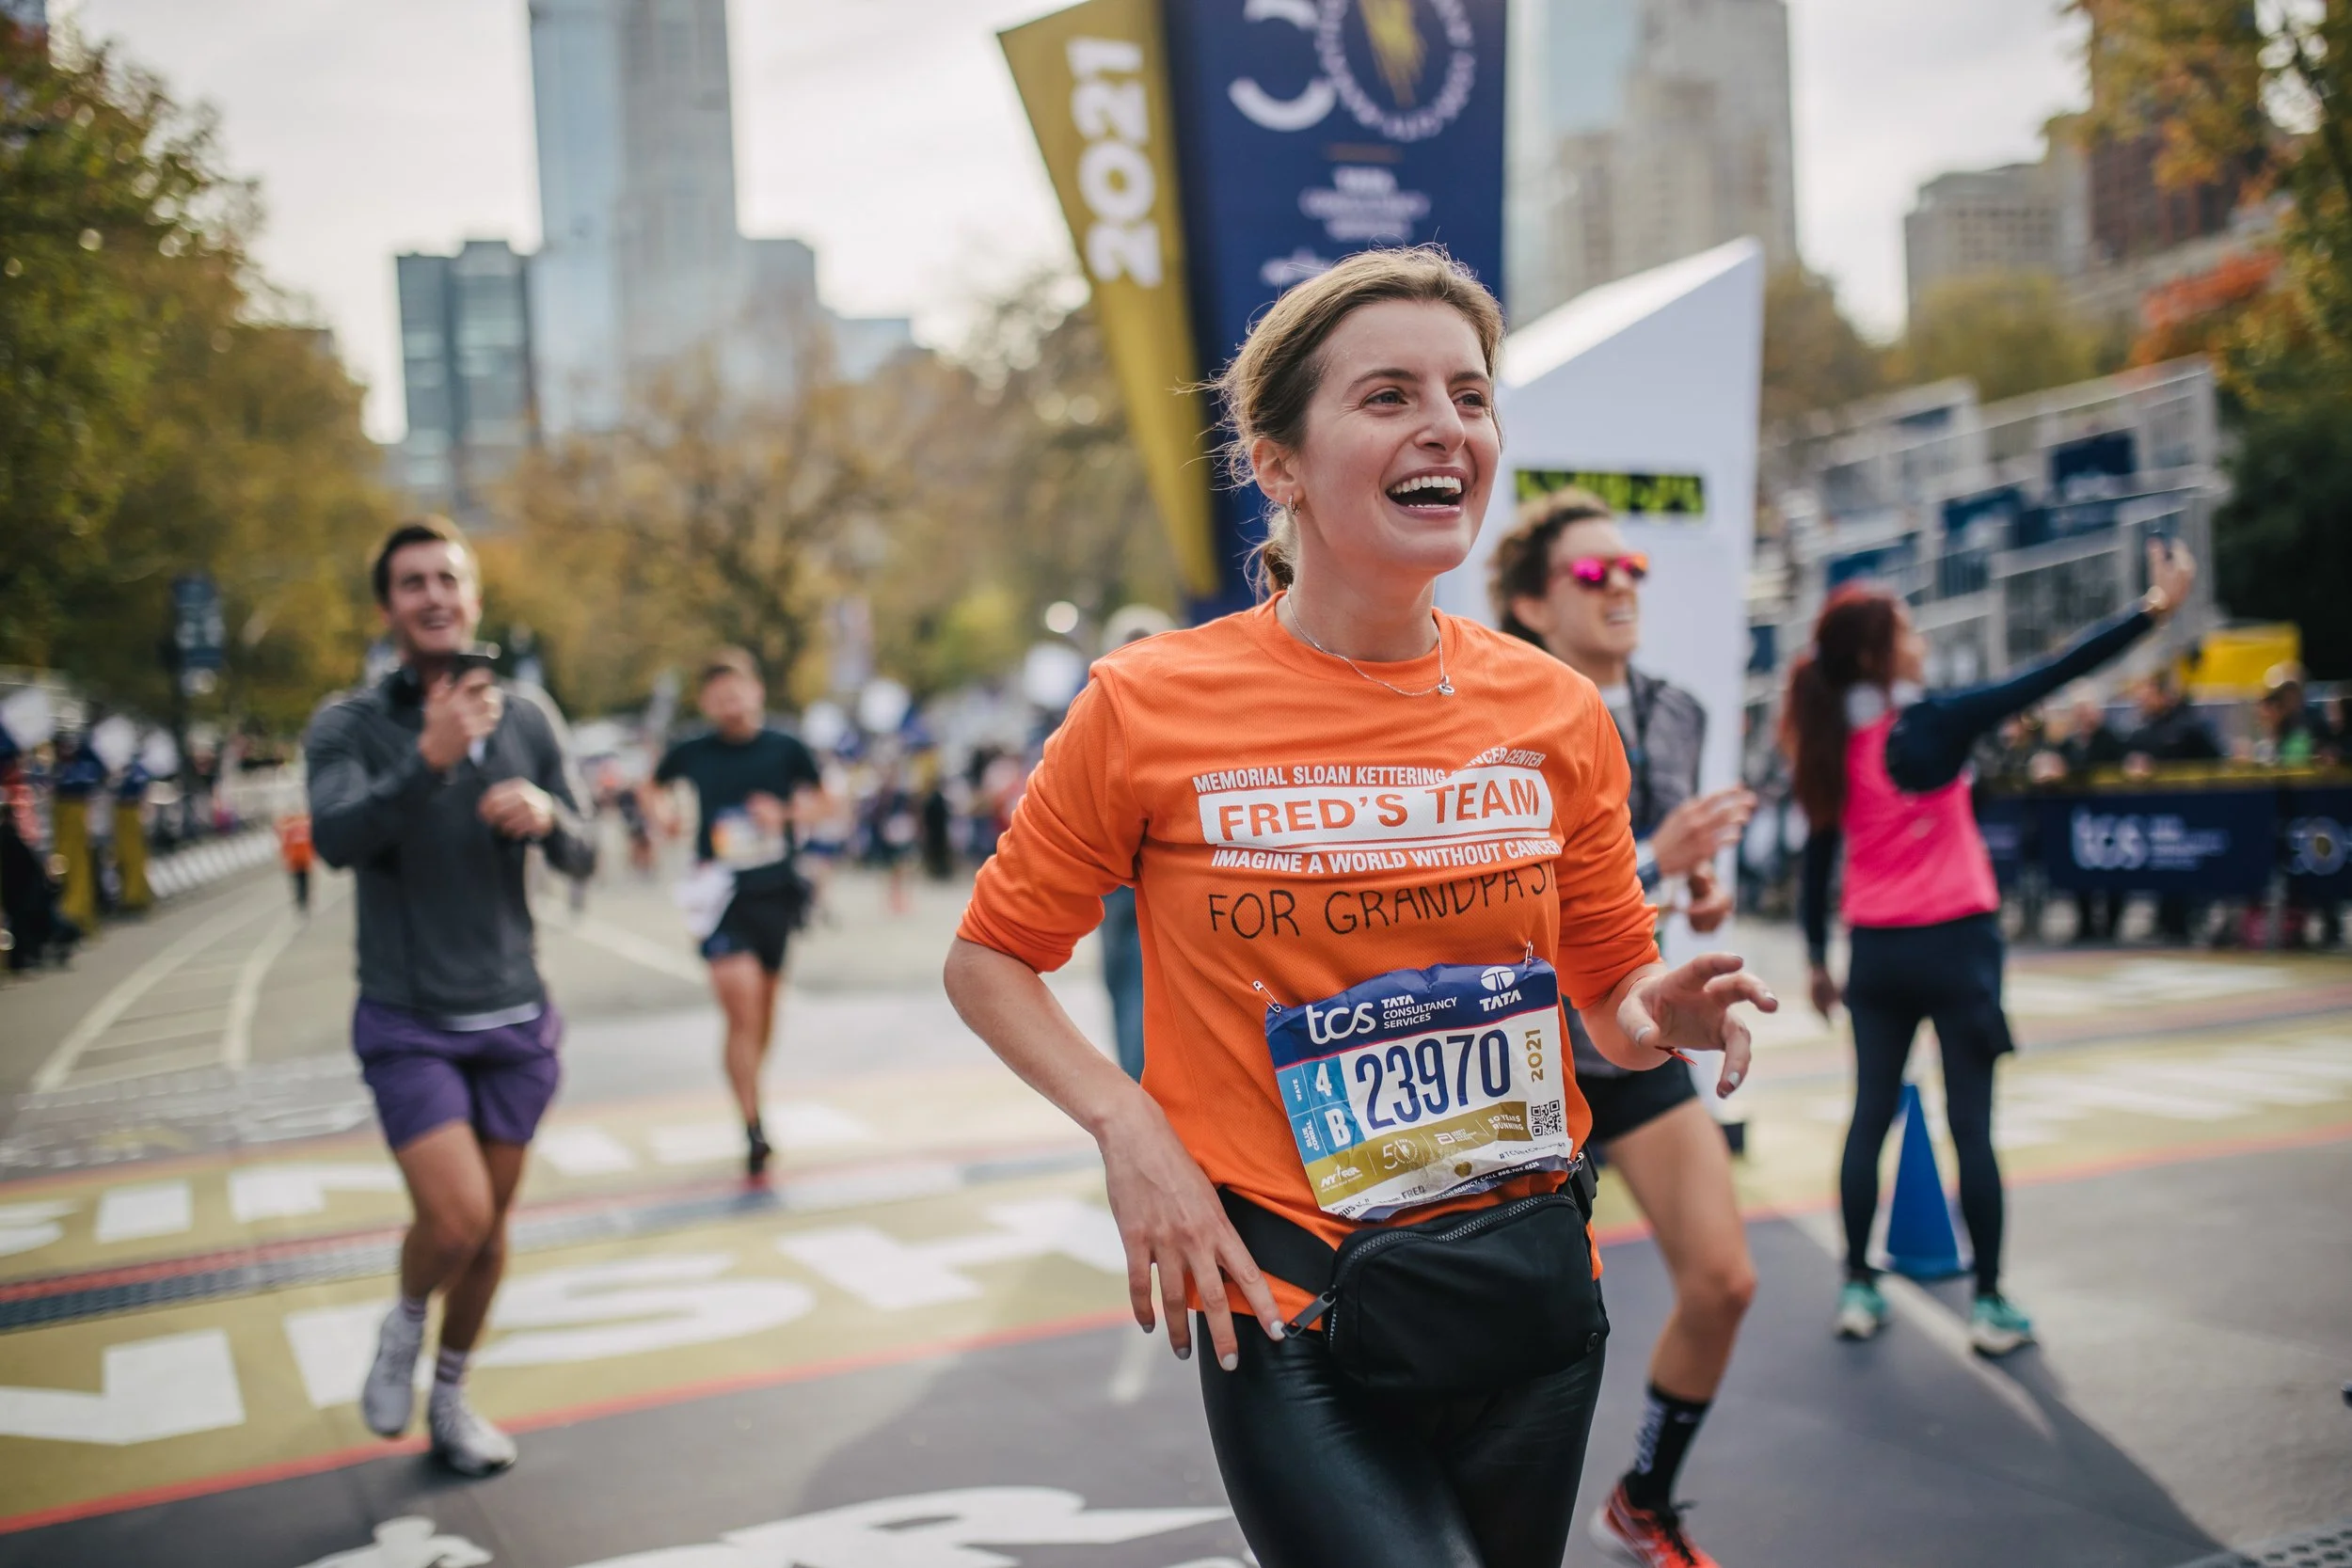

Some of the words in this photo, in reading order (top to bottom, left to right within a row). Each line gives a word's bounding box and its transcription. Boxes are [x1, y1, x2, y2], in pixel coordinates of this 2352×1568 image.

[1065, 36, 1162, 288] 2021
[1192, 767, 1288, 794] MEMORIAL
[1293, 765, 1351, 785] SLOAN
[1356, 766, 1446, 785] KETTERING
[1505, 748, 1548, 768] CENTER
[1218, 793, 1408, 842] FRED'S
[1423, 778, 1540, 824] TEAM
[1211, 849, 1304, 874] IMAGINE
[1307, 853, 1325, 874] A
[1326, 850, 1407, 874] WORLD
[1408, 843, 1502, 868] WITHOUT
[1504, 839, 1563, 860] CANCER
[1208, 889, 1300, 940] FOR
[1380, 993, 1415, 1009] TATA
[1382, 996, 1457, 1020] CONSULTANCY
[1479, 989, 1522, 1012] TATA
[1305, 1002, 1376, 1045] tcs
[1383, 1012, 1431, 1029] SERVICES
[1524, 1028, 1545, 1084] 2021
[1292, 1078, 1303, 1102] WAVE
[1315, 1062, 1333, 1098] 4
[1354, 1028, 1512, 1131] 23970
[1306, 1118, 1320, 1151] CORRAL
[1324, 1108, 1352, 1148] B
[1492, 1122, 1524, 1132] RUNNING
[1500, 1114, 1521, 1123] YEARS
[1301, 1127, 1313, 1148] BLUE
[1401, 1184, 1426, 1200] FRED
[1479, 1174, 1497, 1183] CALL
